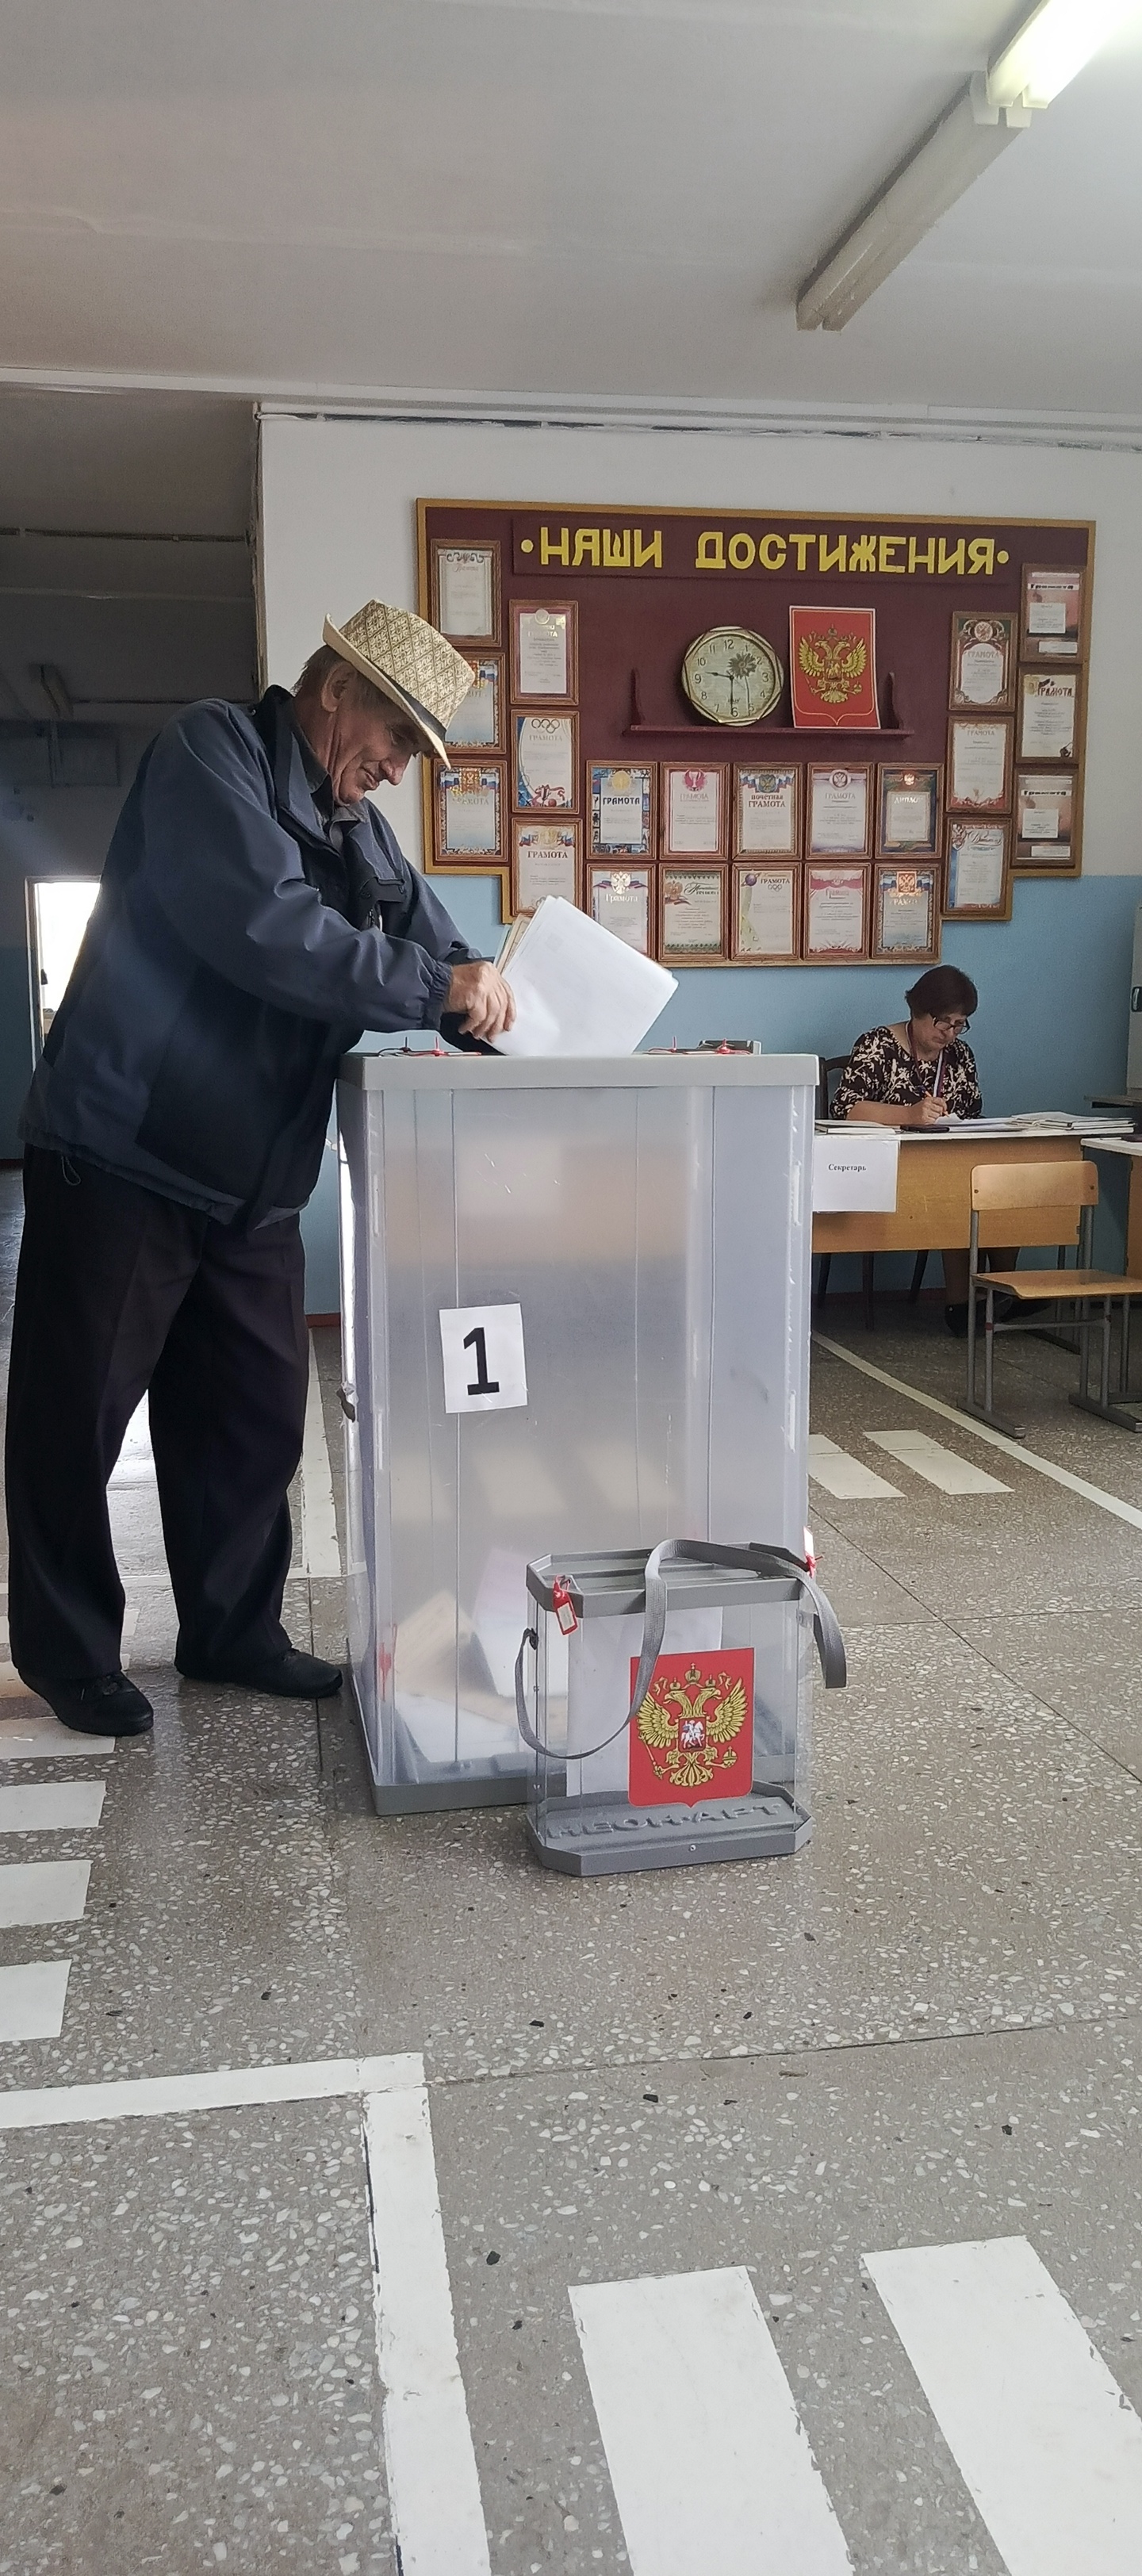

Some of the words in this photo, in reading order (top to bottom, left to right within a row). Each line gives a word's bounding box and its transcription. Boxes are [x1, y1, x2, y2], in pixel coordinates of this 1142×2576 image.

[540, 527, 662, 568] НАШИ
[696, 531, 994, 575] ДОСТИЖЕНИЯ
[724, 639, 734, 650] 12
[697, 657, 706, 666] 10
[694, 673, 702, 684] 9
[762, 673, 769, 682] 3
[605, 893, 638, 903] Грамота
[828, 1163, 867, 1172] Секретарь
[463, 1327, 500, 1395] 1
